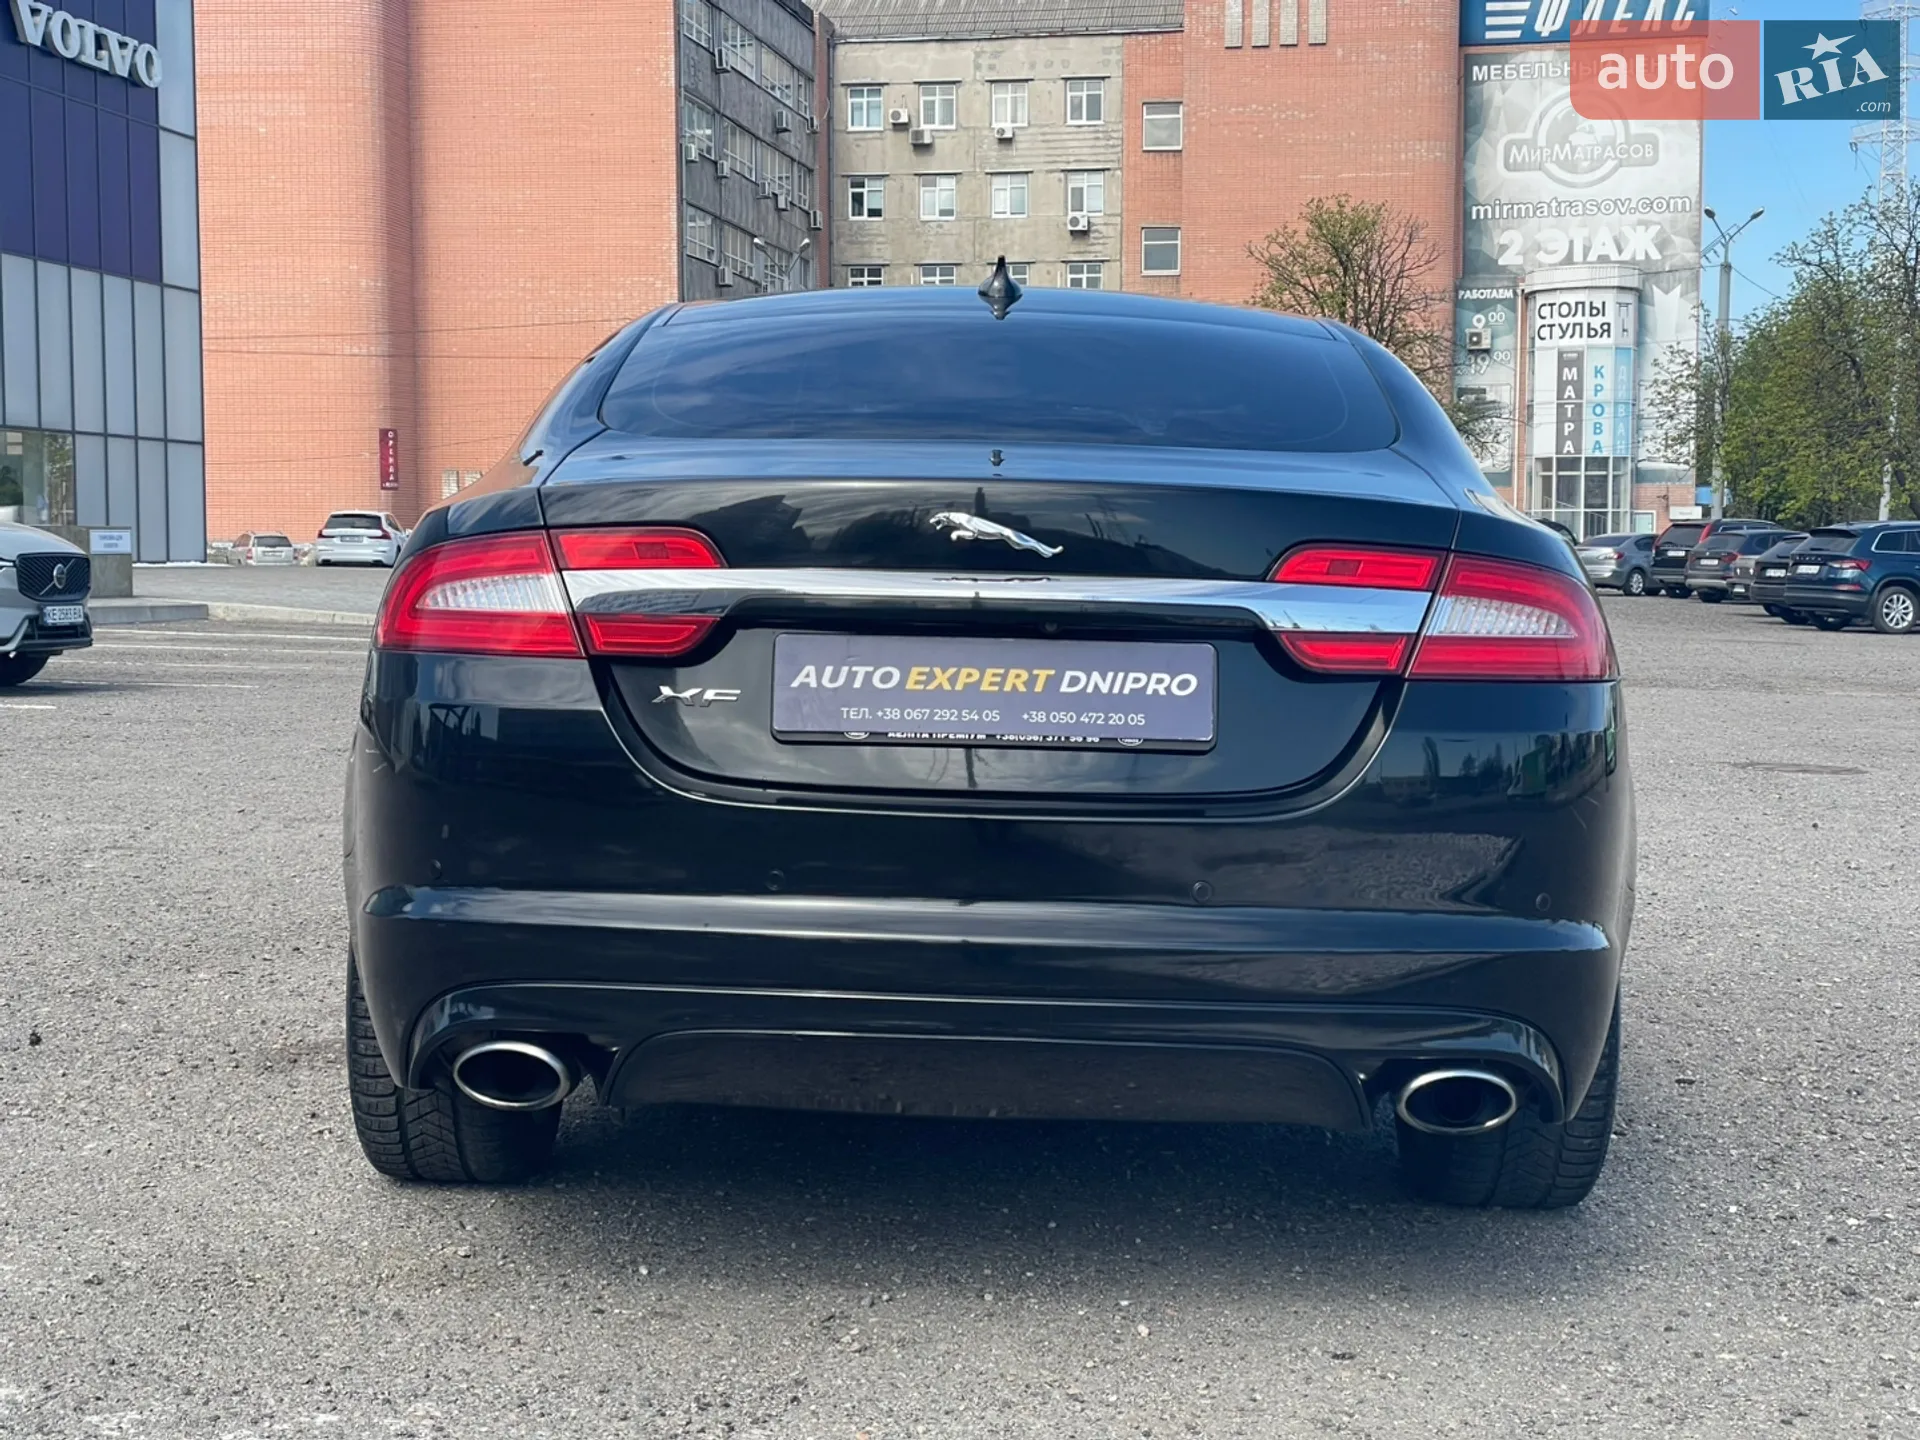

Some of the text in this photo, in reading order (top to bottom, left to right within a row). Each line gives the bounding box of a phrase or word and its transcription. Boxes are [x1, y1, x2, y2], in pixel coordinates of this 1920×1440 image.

[14, 0, 163, 88] VOLVO
[1471, 195, 1692, 220] mirmatrasov.com
[1497, 225, 1662, 265] 2 ЭТАЖ
[1458, 288, 1514, 299] РАБОТАЕМ
[1488, 312, 1506, 322] 00
[1537, 301, 1606, 319] СТОЛЫ
[1537, 322, 1612, 340] СТУЛЬЯ
[1563, 367, 1578, 453] МАТРА
[1592, 365, 1605, 453] КРОВА
[790, 665, 1198, 697] AUTO EXPERT DNIPRO
[652, 685, 742, 707] XF
[840, 707, 1001, 722] ТЕЛ. +38 067 292 54 05
[1022, 711, 1146, 726] +38 050 472 20 05
